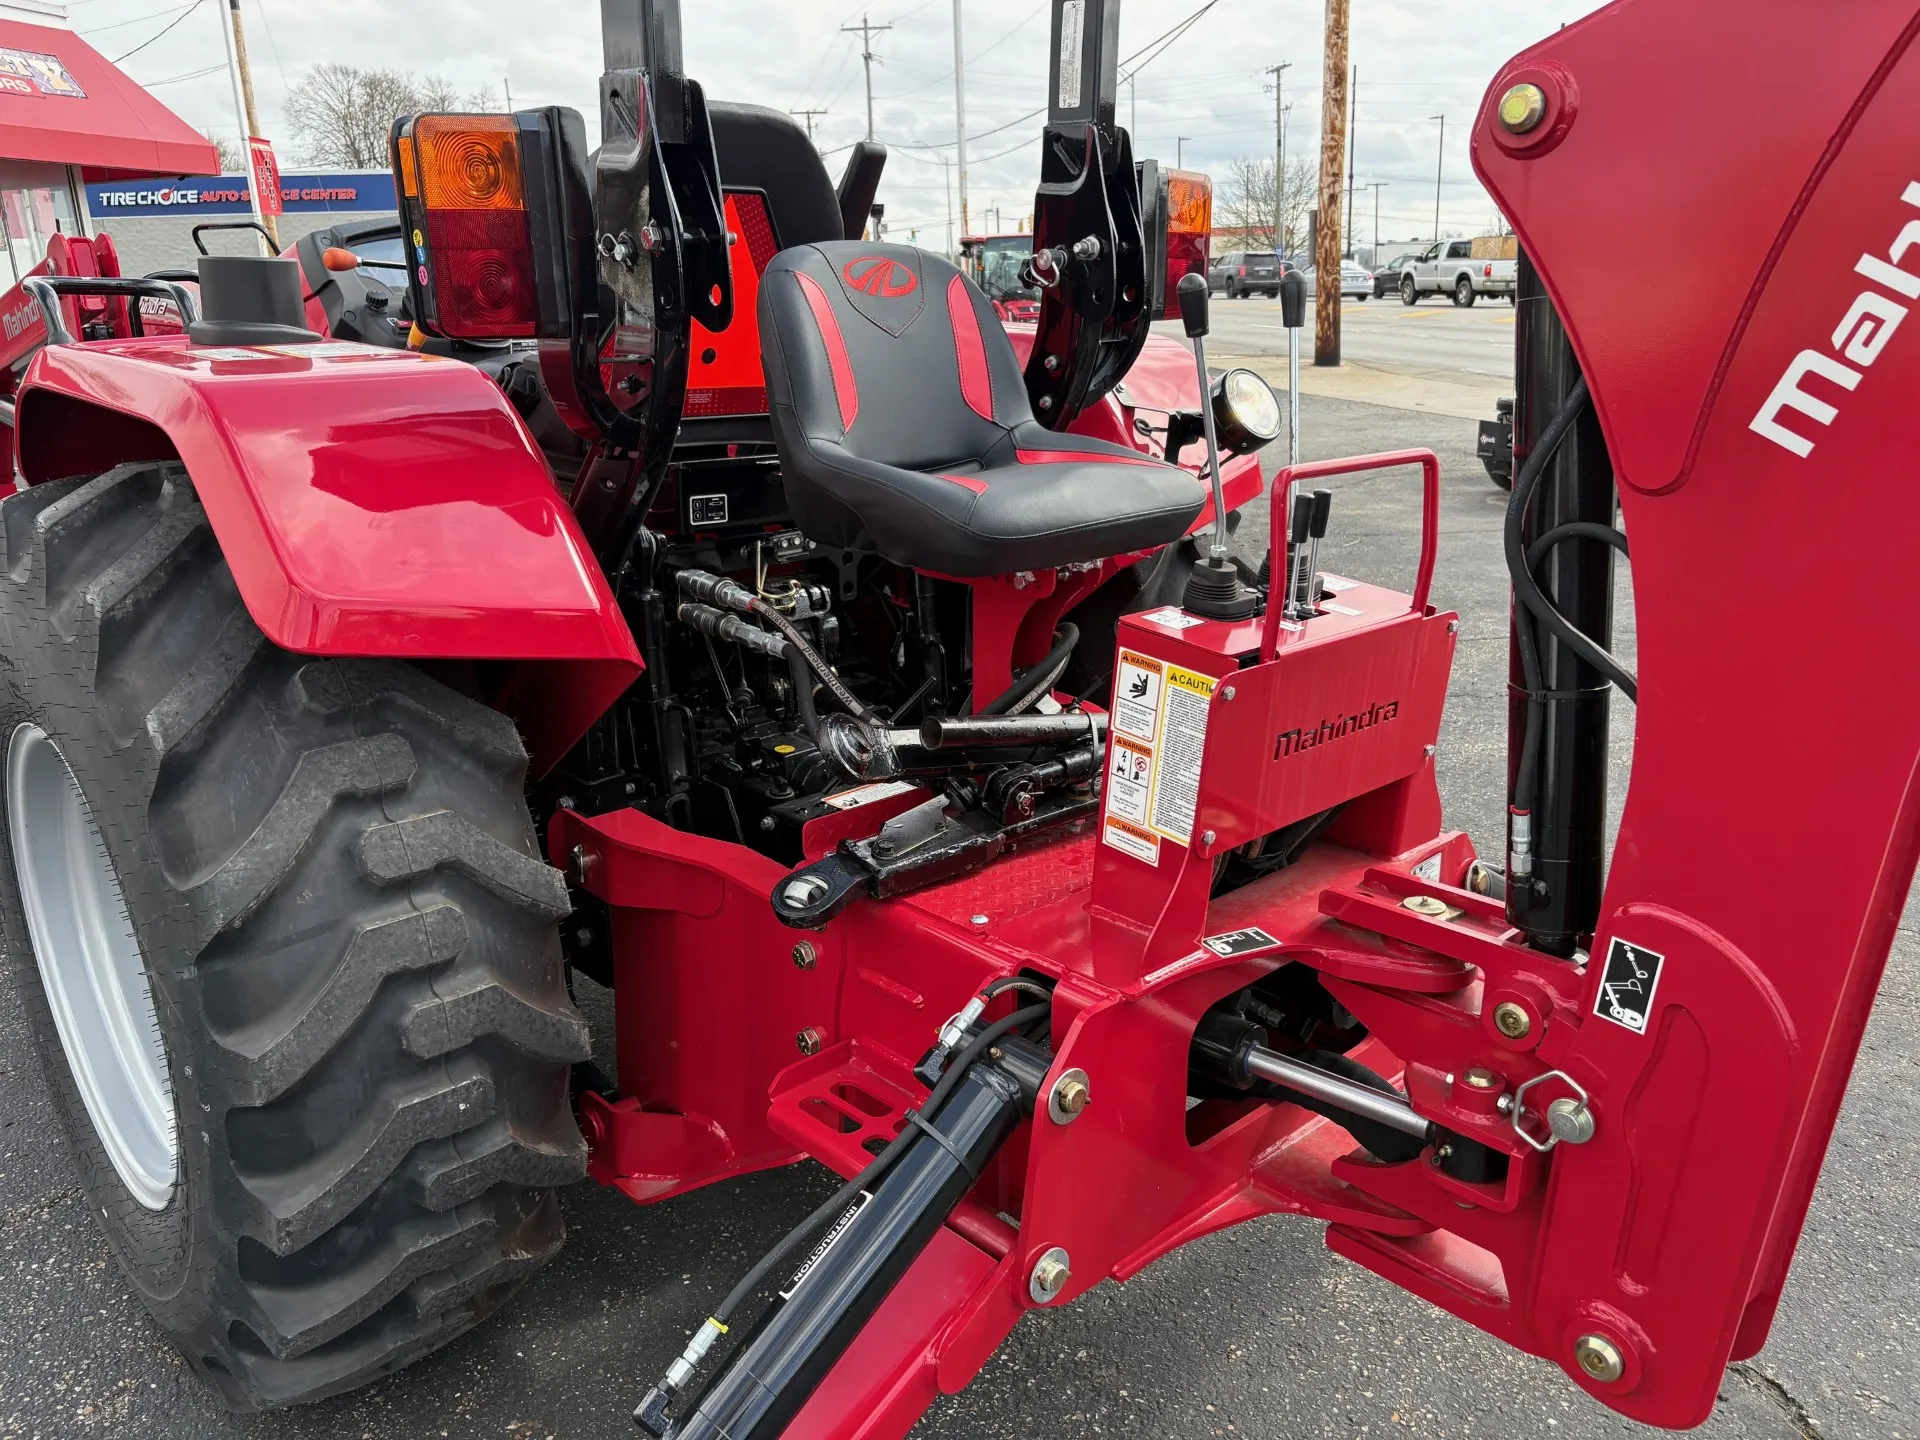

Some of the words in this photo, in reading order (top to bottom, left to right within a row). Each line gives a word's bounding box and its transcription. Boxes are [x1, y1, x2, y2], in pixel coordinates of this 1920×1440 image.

[200, 190, 239, 202] AUTO
[302, 188, 357, 200] CENTER
[2, 295, 44, 341] Mahindr
[1130, 655, 1161, 672] WARNING
[803, 646, 854, 706] Weatherhead
[1179, 674, 1214, 694] CAUTI
[1273, 700, 1399, 762] Mahindra
[1122, 740, 1150, 755] WARNING
[1121, 824, 1151, 842] WARNING
[794, 1205, 858, 1282] INSTRUCTION
